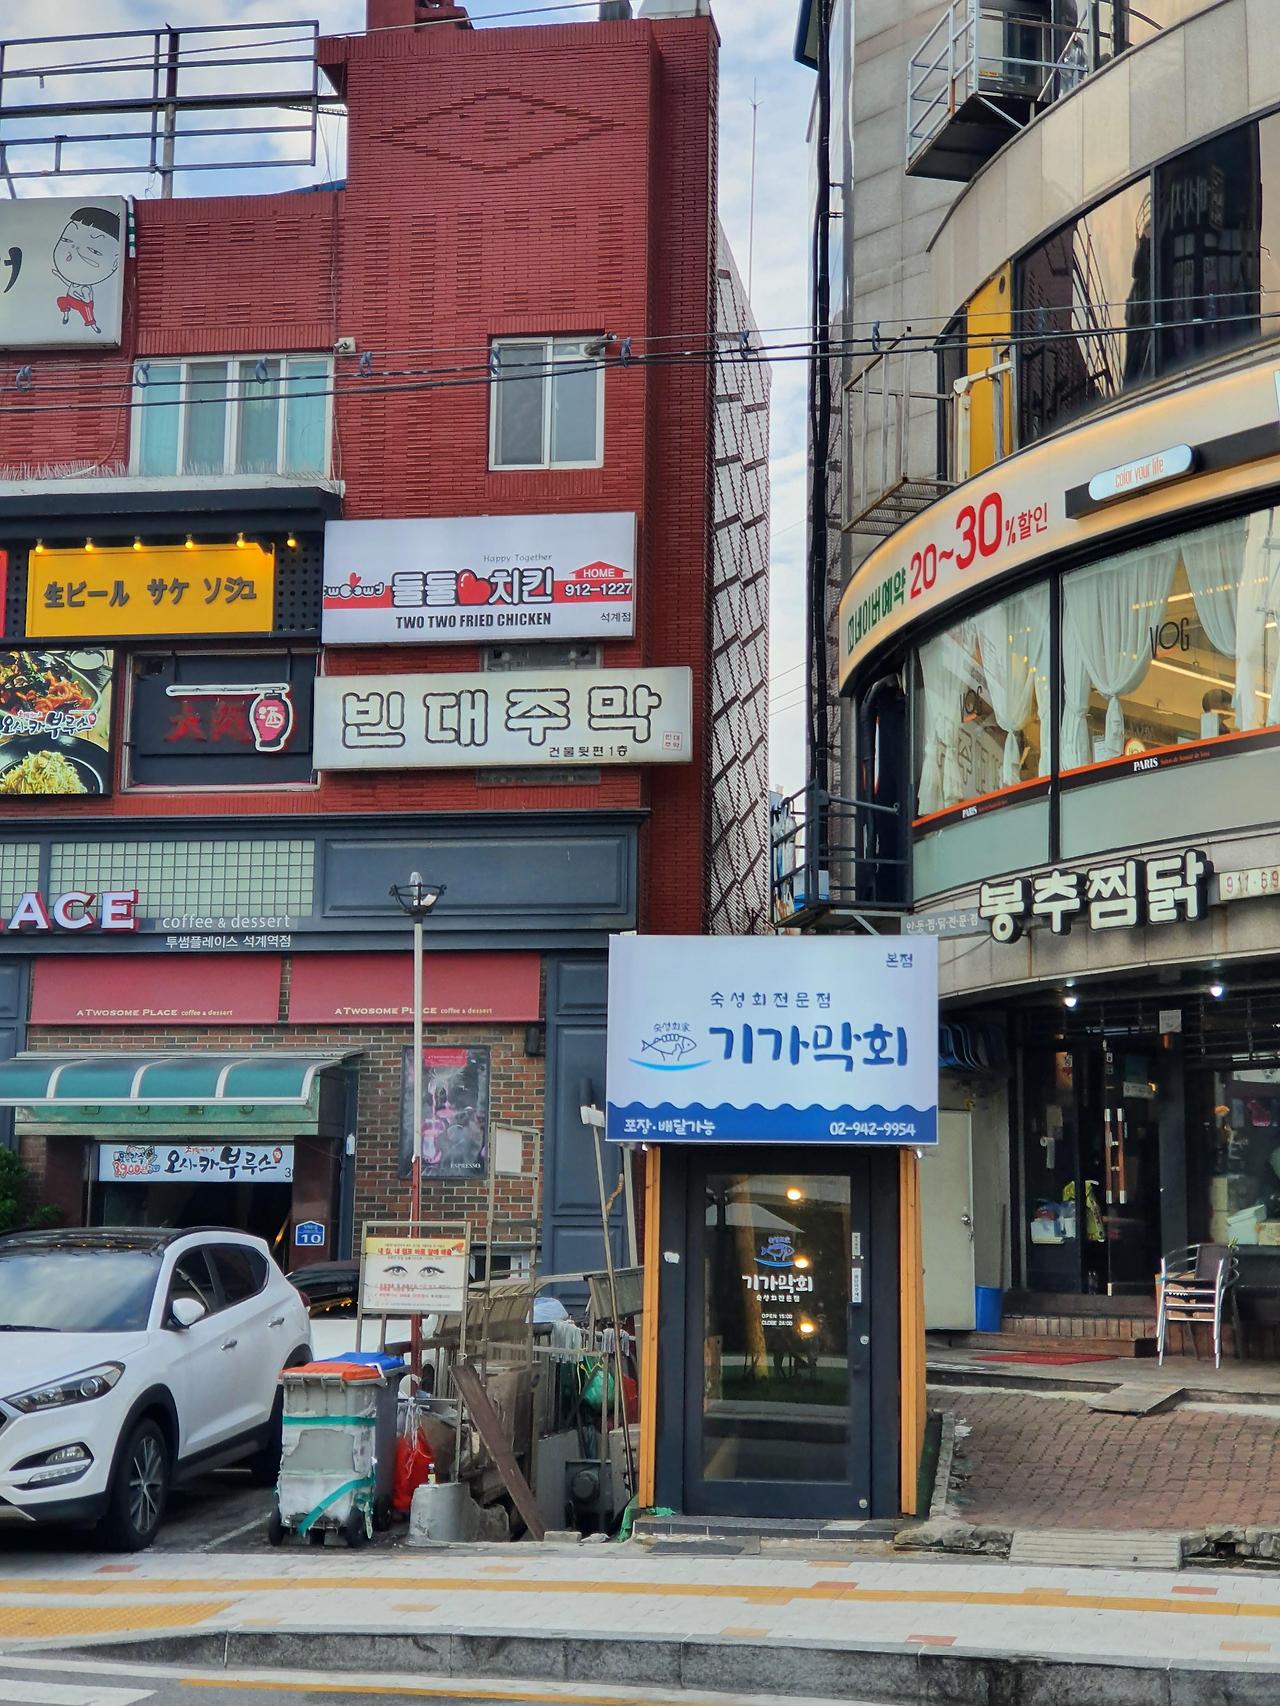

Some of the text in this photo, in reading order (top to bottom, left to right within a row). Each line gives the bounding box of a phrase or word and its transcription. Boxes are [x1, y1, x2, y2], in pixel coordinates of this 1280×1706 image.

[1136, 461, 1150, 481] your
[1152, 456, 1164, 475] life
[483, 553, 553, 563] Happy Together
[583, 568, 615, 578] HOME
[44, 575, 257, 608] 生ビール サケ ソジュ
[391, 567, 554, 607] 둘둘 치킨
[565, 582, 633, 596] 912-1227
[854, 567, 906, 645] 네이버예약
[396, 612, 551, 629] TWO TWO FRIED CHICKEN
[601, 612, 632, 622] 석계점
[1150, 617, 1190, 659] VOG
[342, 684, 662, 749] 빈대주막
[1133, 757, 1159, 772] PARIS
[979, 849, 1213, 943] 봉추찜닭
[162, 913, 290, 929] coffee & dessert
[166, 934, 291, 948] 투썸플레이스 석계역점
[885, 952, 913, 968] 본점
[344, 1007, 398, 1015] TWOSOME
[709, 1022, 909, 1073] 기가막회
[829, 1120, 916, 1137] 02-942-9954
[301, 1234, 322, 1244] 10
[741, 1274, 814, 1294] 기가막회
